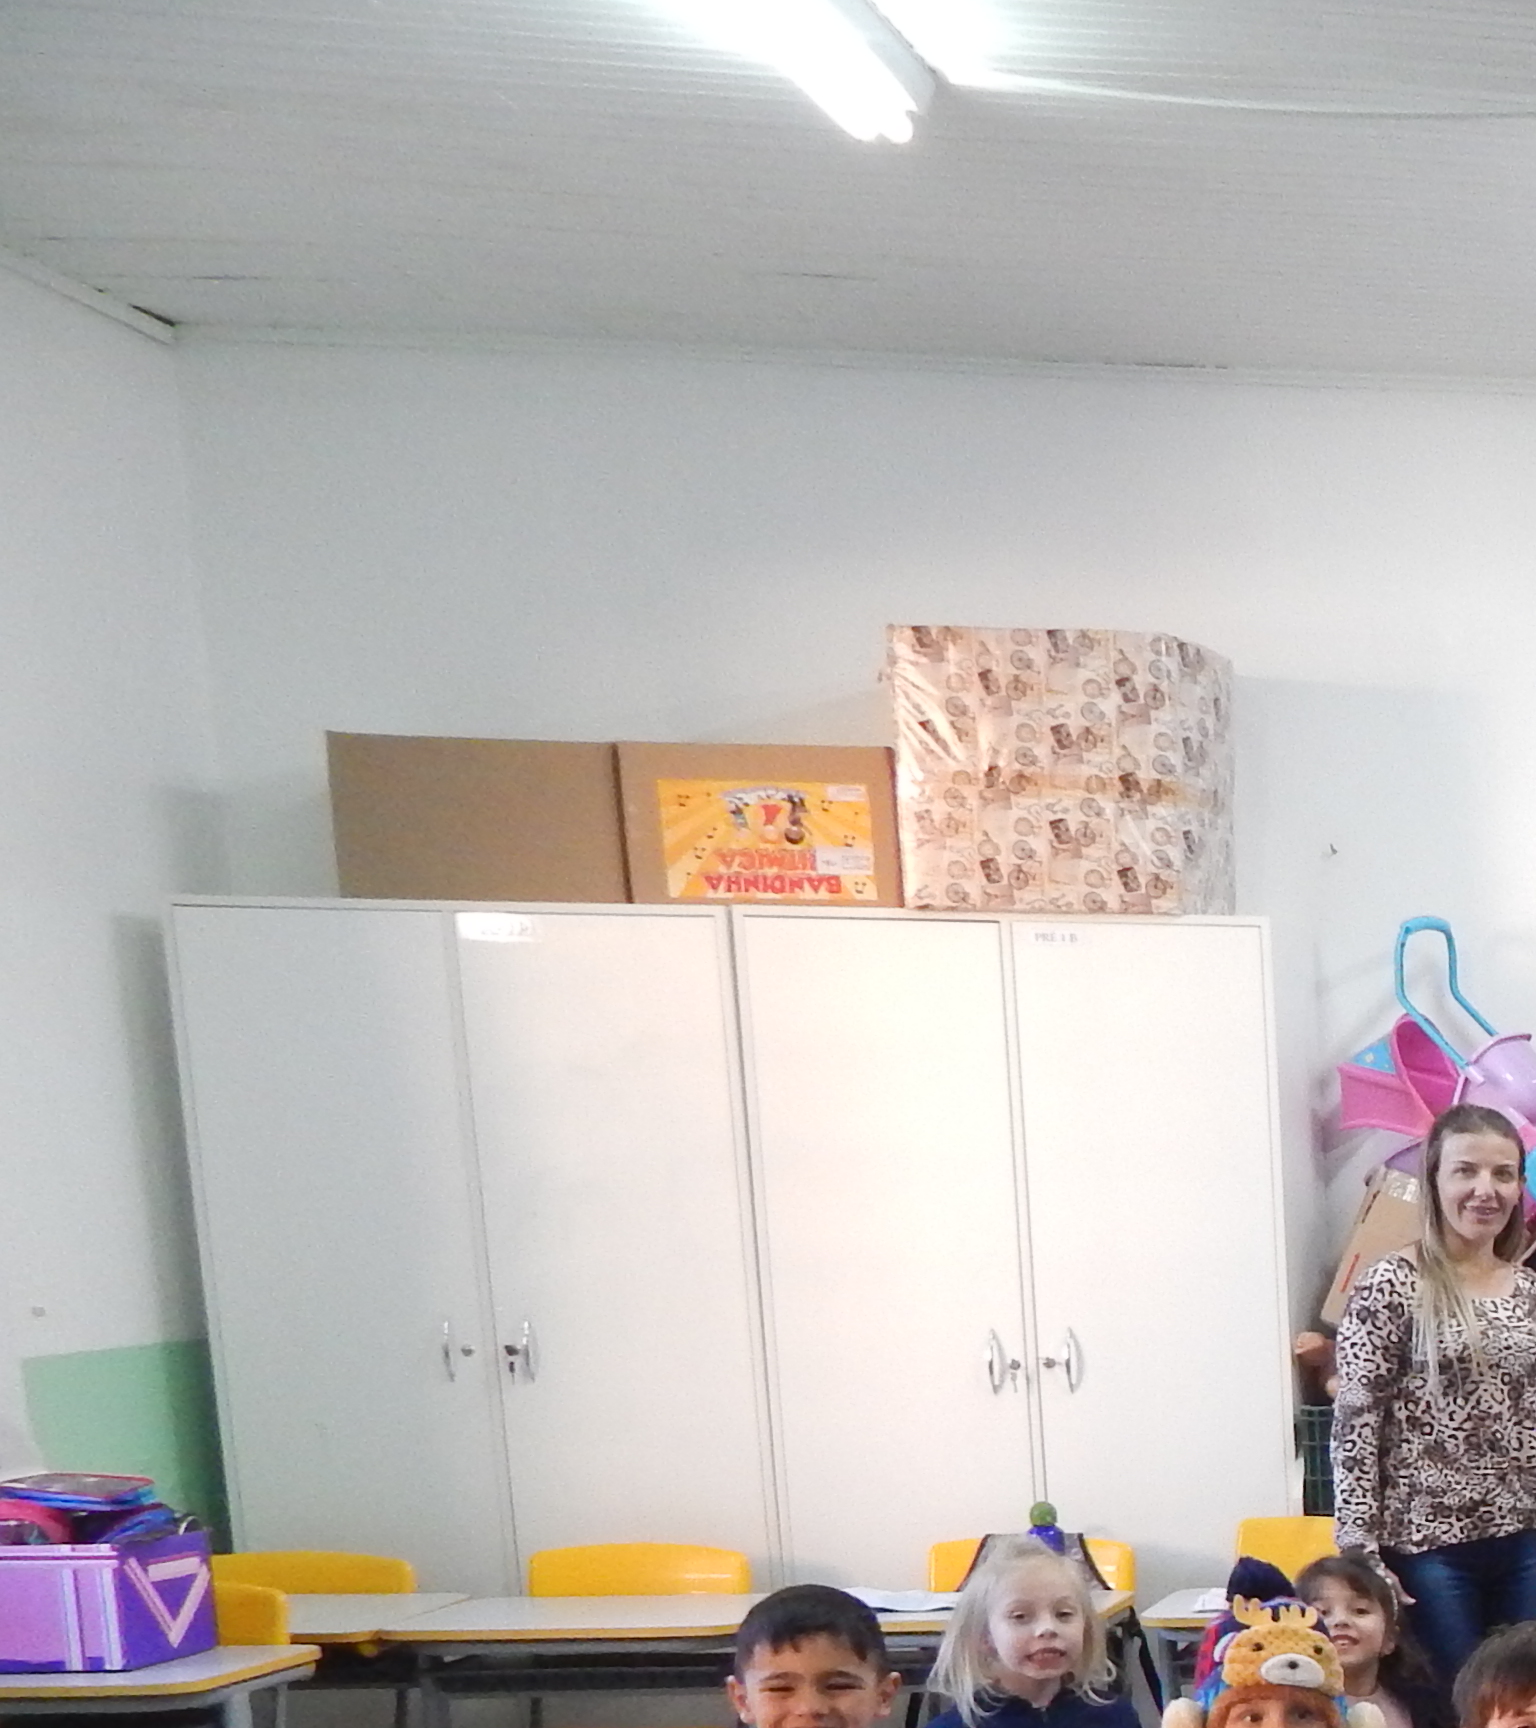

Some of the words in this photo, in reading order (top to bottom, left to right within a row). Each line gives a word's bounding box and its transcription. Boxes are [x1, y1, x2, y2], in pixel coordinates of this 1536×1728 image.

[705, 874, 842, 894] BANDINHA
[1034, 930, 1056, 943] PRÉ
[1069, 932, 1078, 943] B
